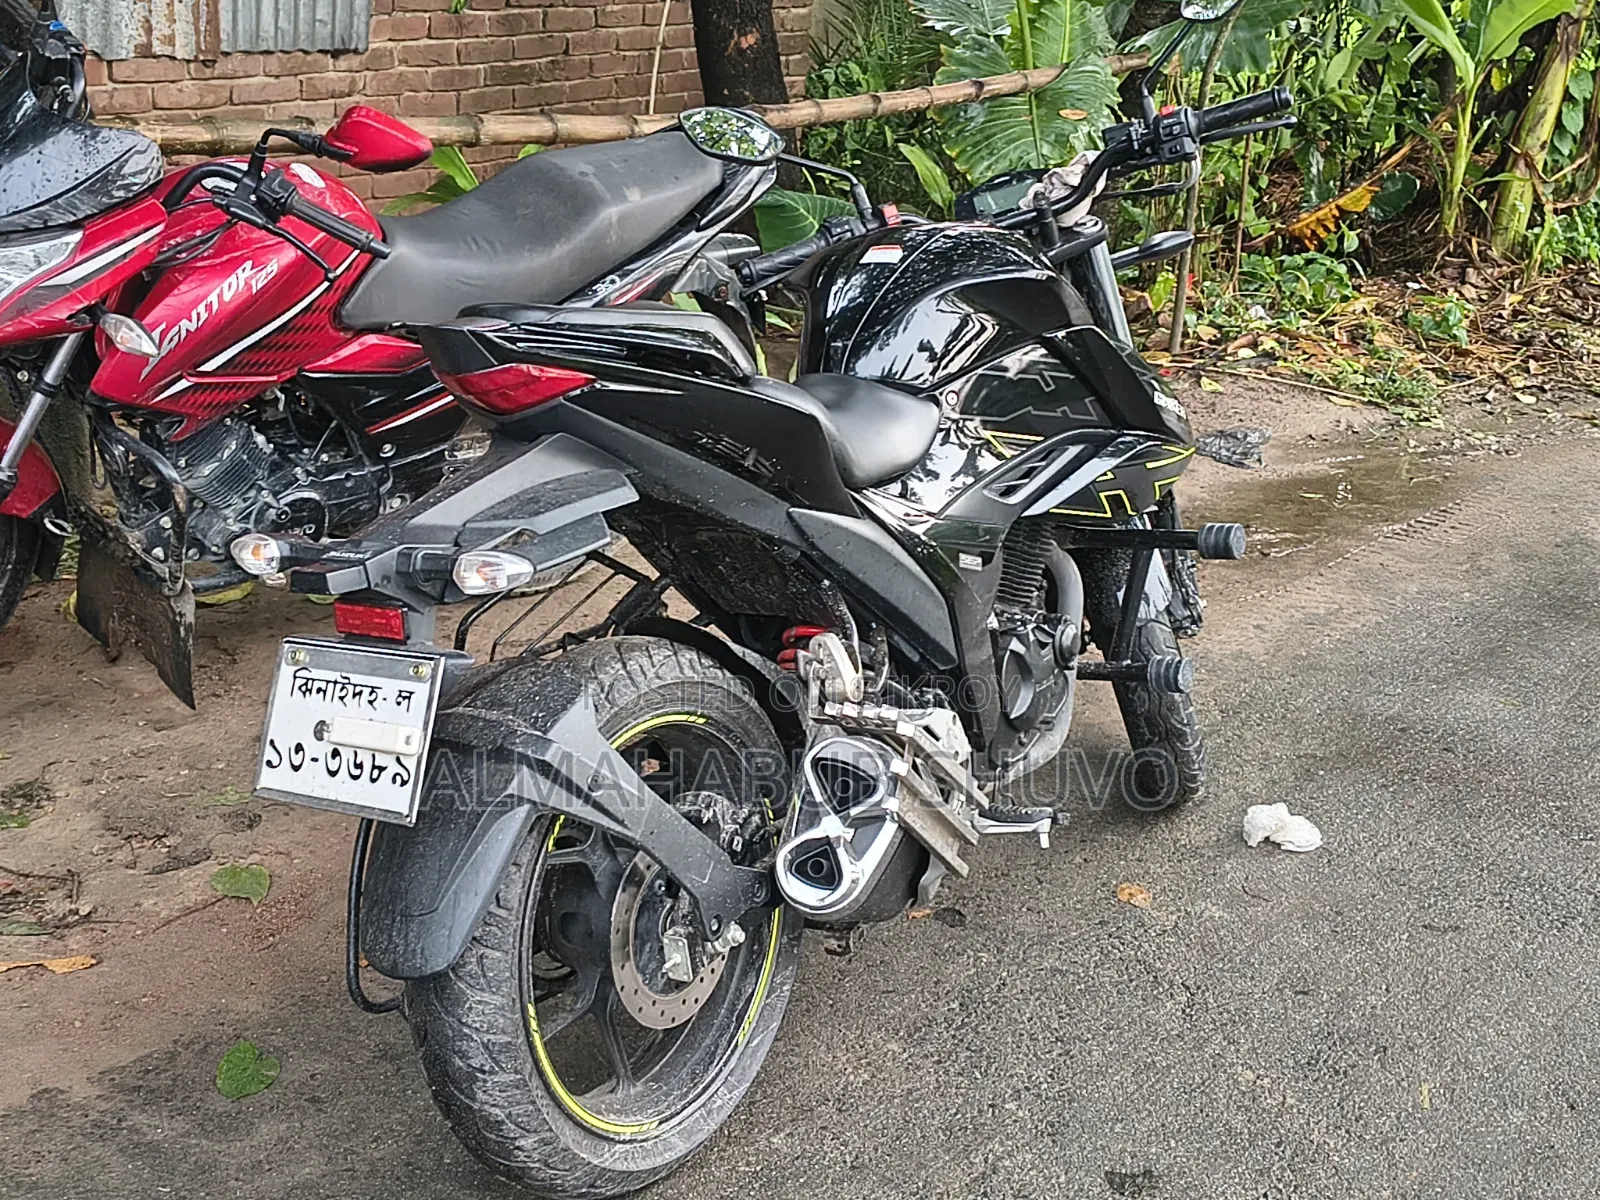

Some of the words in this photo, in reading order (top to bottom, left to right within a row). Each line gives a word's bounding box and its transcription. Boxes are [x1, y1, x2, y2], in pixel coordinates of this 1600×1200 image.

[250, 257, 279, 295] 125
[139, 260, 267, 383] IGNITOR
[265, 738, 411, 788] ১৩-৩৬৮৯
